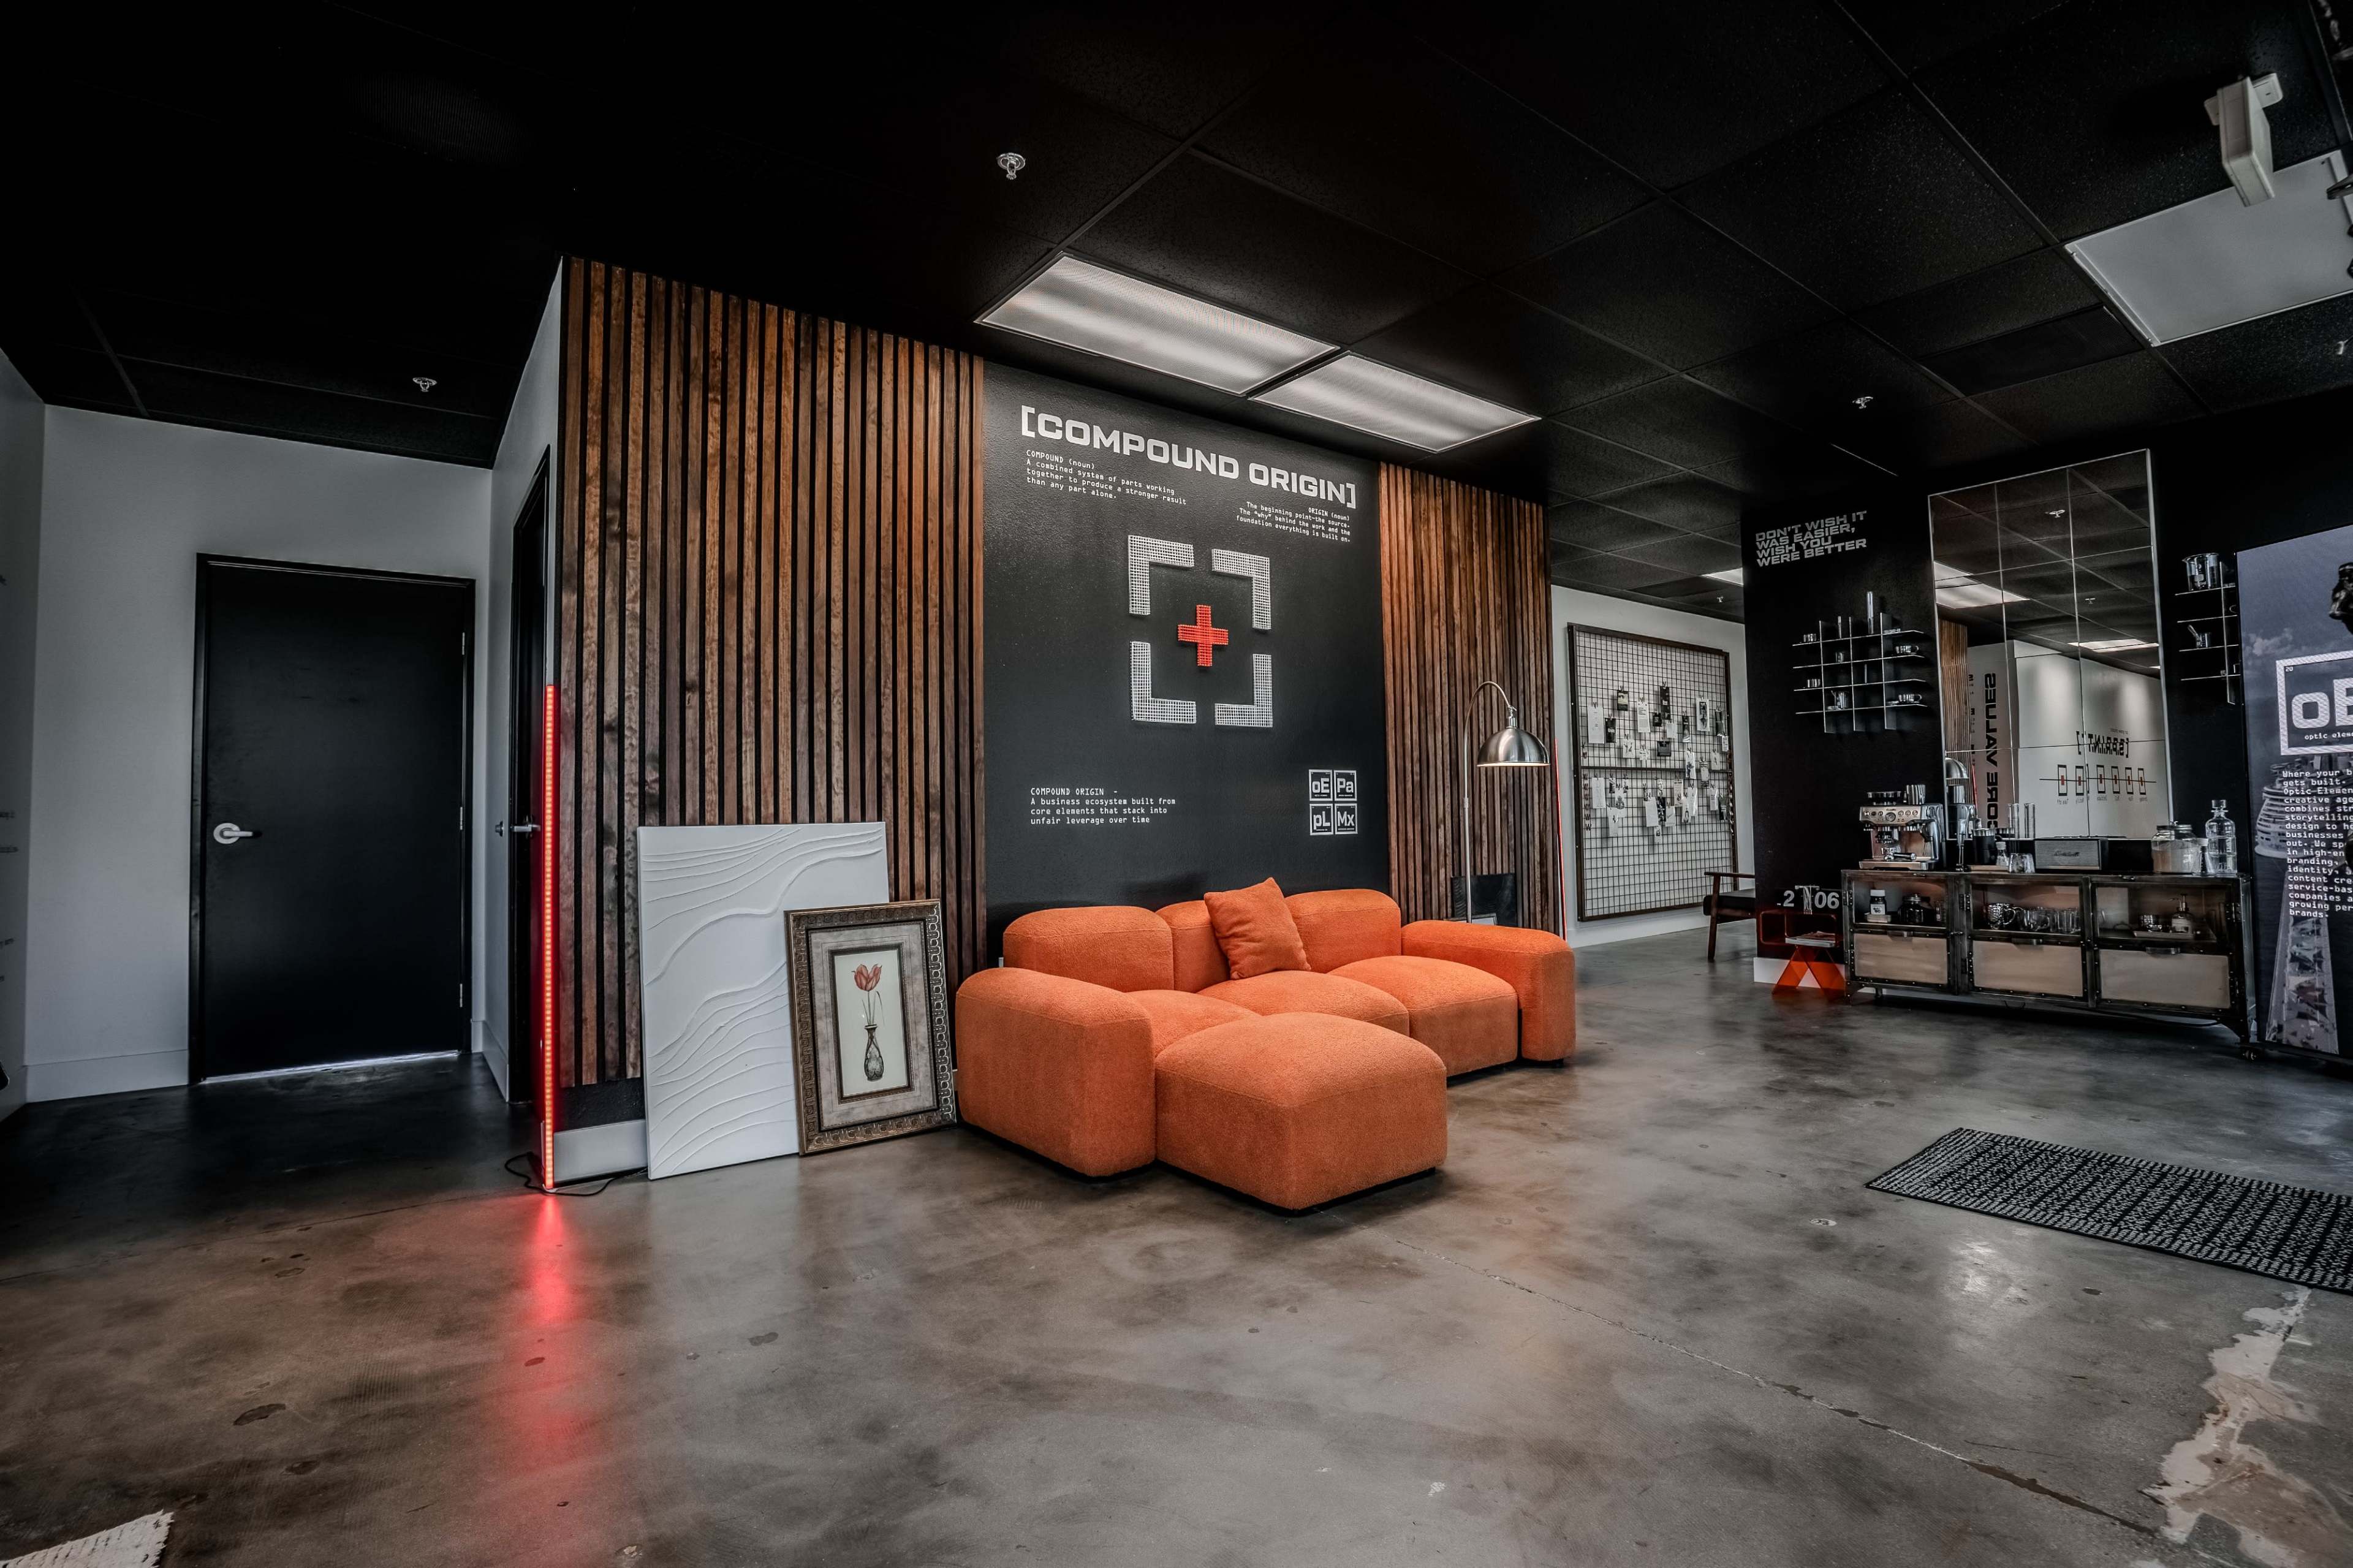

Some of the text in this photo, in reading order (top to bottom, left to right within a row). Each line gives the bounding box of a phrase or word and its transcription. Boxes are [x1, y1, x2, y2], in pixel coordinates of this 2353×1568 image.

[1021, 405, 1356, 509] [COMPOUND ORIGIN]
[1026, 450, 1094, 469] COMPOUND (noun)
[1036, 461, 1073, 474] combined
[1078, 469, 1104, 480] system
[1121, 479, 1142, 488] parts
[1146, 483, 1175, 496] working
[1027, 468, 1064, 481] together
[1082, 480, 1113, 491] produce
[1126, 488, 1159, 499] stronger
[1162, 495, 1186, 505] result
[1027, 477, 1116, 499] than any part alone.
[1261, 505, 1292, 518] beginning
[1308, 507, 1349, 521] ORIGIN (noun)
[1237, 515, 1272, 528] foundation
[1275, 523, 1309, 536] everything
[1322, 532, 1338, 540] built
[1275, 515, 1296, 525] behind
[1756, 510, 1867, 541] DON'T WISH IT
[1756, 523, 1855, 550] WAS EASIER,
[1756, 536, 1832, 558] WISH YOU
[1757, 538, 1867, 567] WERE BETTER
[1312, 778, 1330, 793] oE
[1337, 778, 1354, 793] Pa
[2283, 787, 2311, 796] Optic
[1085, 798, 1127, 806] ecosystem
[1066, 817, 1104, 825] leverage
[1313, 811, 1330, 830] pL
[1337, 811, 1355, 827] Mx
[2285, 822, 2319, 831] design
[2287, 858, 2339, 867] branding,
[2287, 865, 2339, 876] identity,
[1814, 892, 1840, 909] 06
[2289, 893, 2341, 901] companies
[2289, 901, 2330, 911] growing
[2289, 909, 2329, 918] brands.
